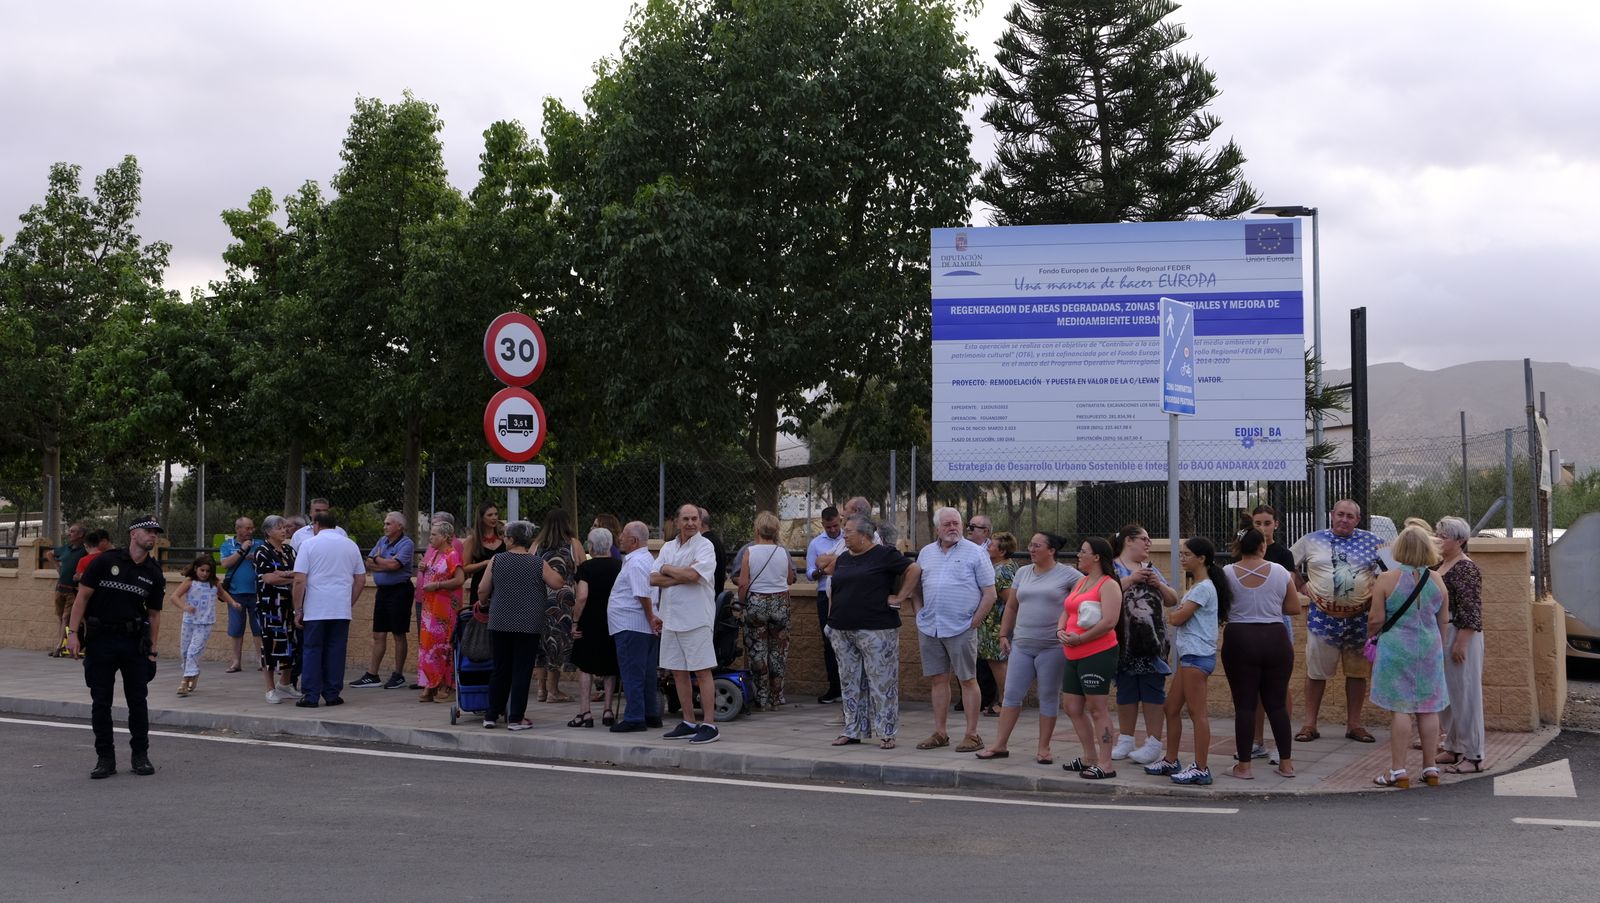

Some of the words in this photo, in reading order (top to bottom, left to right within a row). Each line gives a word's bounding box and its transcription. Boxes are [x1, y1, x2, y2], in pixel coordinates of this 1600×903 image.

[1136, 265, 1166, 273] Regional
[1015, 277, 1041, 291] Una
[1047, 281, 1096, 290] manera
[1100, 275, 1115, 289] de
[1119, 275, 1153, 288] hacer
[1158, 272, 1216, 288] EUROPA
[950, 305, 1017, 315] REGENERACION
[1019, 304, 1030, 313] DE
[1031, 304, 1060, 313] AREAS
[1062, 303, 1124, 313] DEGRADADAS,
[1125, 302, 1155, 311] ZONAS
[1222, 300, 1228, 309] Y
[1229, 299, 1267, 309] MEJORA
[1268, 299, 1280, 308] DE
[1056, 316, 1131, 326] MEDIOAMBIENTE
[1132, 315, 1161, 325] URBAN
[500, 337, 535, 363] 30
[989, 376, 1042, 386] REMODELACIÓN
[1087, 377, 1109, 385] VALOR
[505, 465, 525, 473] EXCEPTO
[948, 462, 993, 472] Estrategia
[994, 462, 1006, 471] de
[1007, 462, 1053, 471] Desarrollo
[1054, 461, 1087, 471] Urbano
[1088, 461, 1136, 471] Sostenible
[1190, 461, 1214, 470] BAJO
[1215, 460, 1260, 470] ANDARAX
[1261, 460, 1287, 470] 2020
[515, 476, 545, 485] AUTORIZADOS
